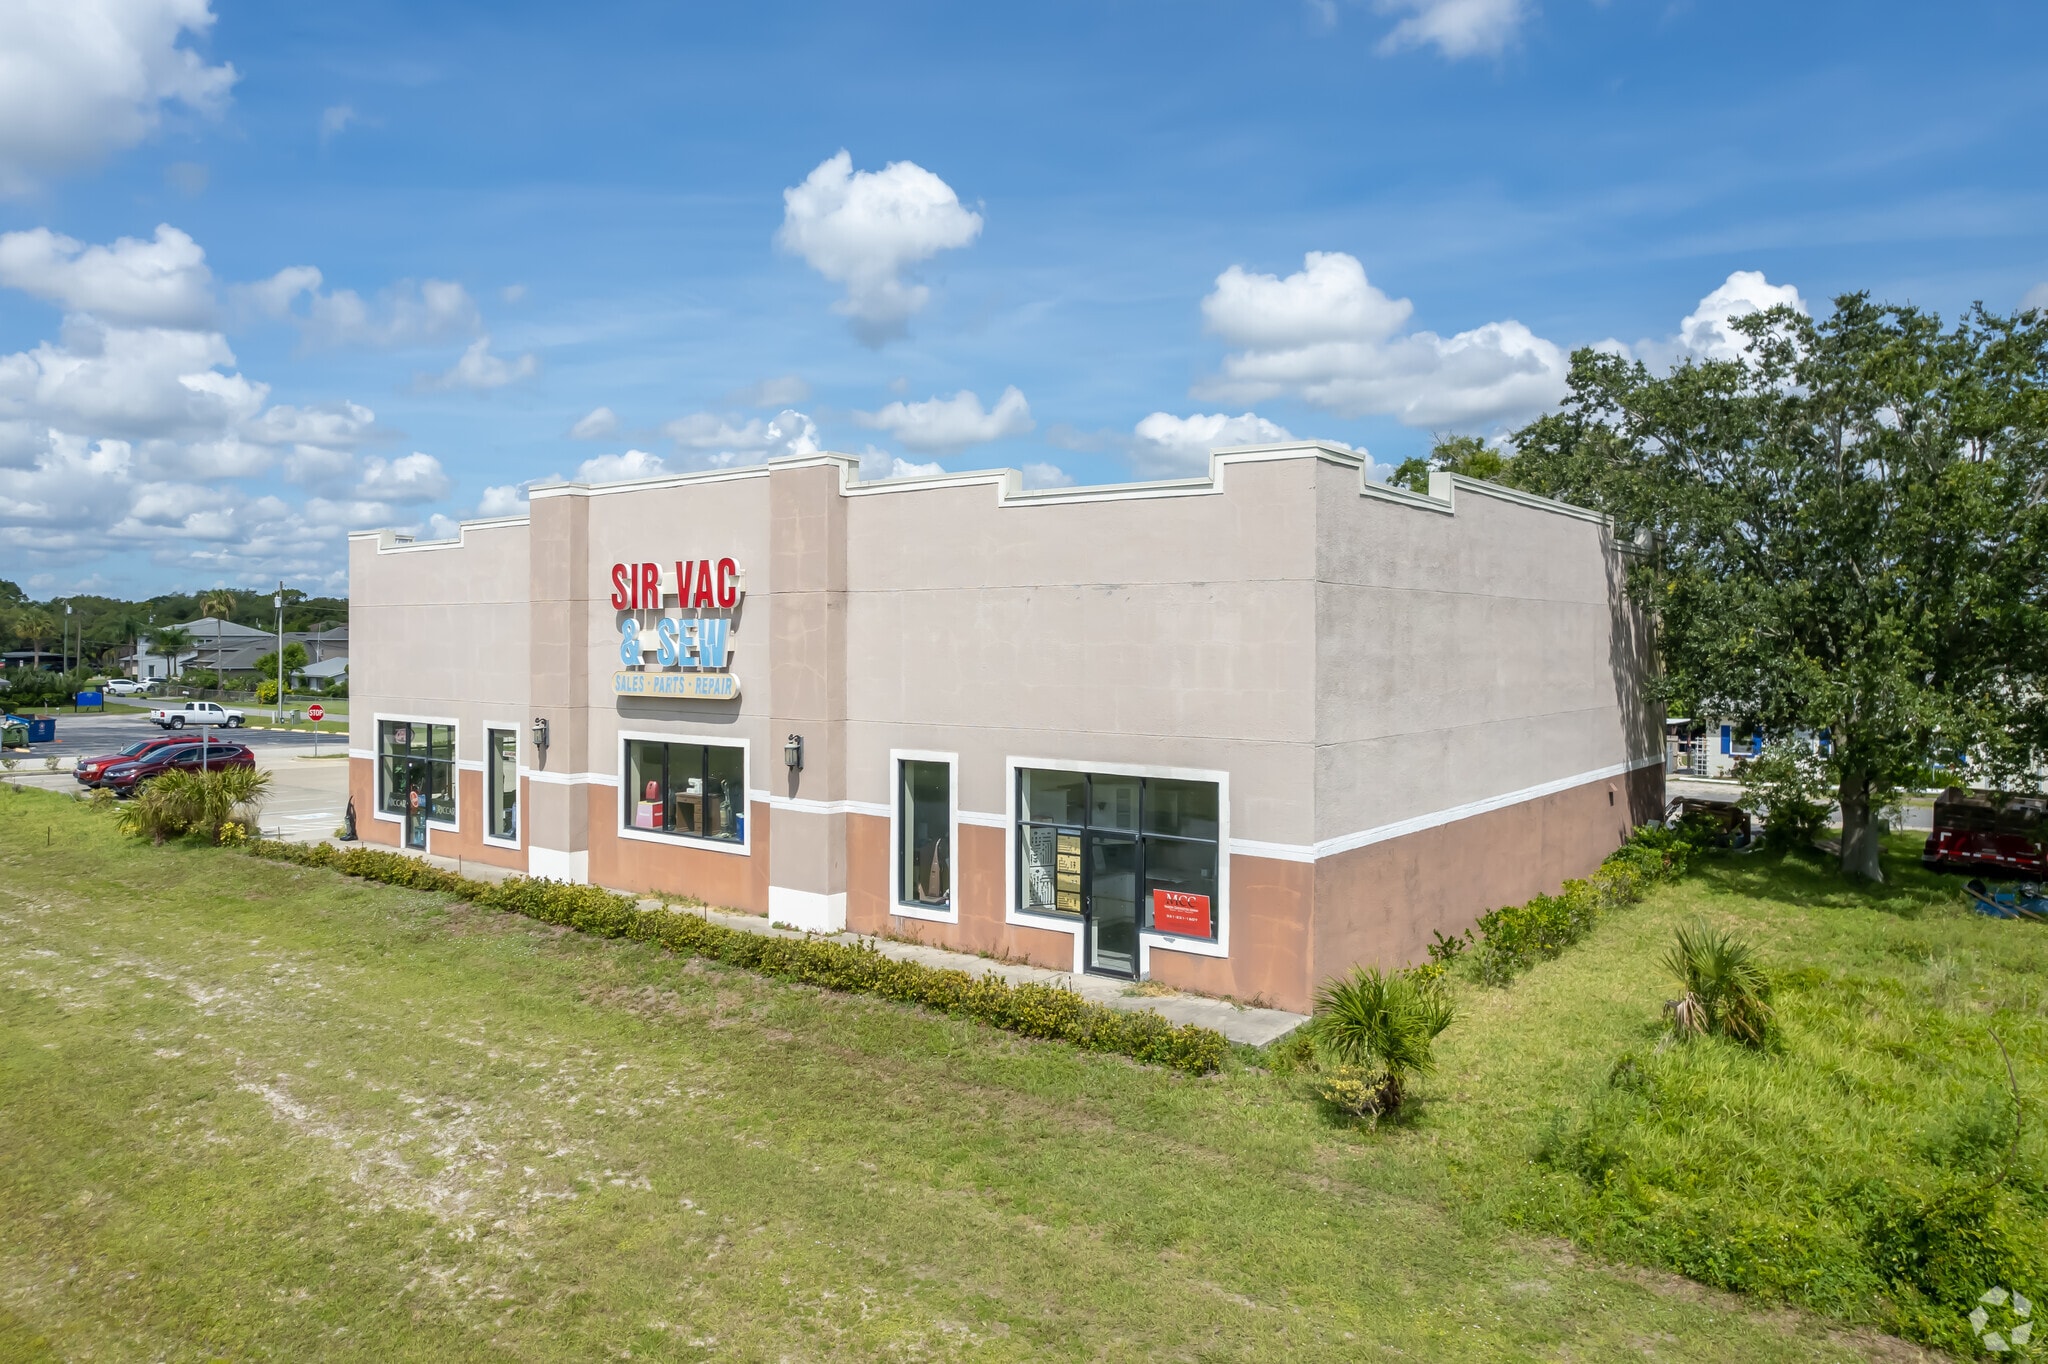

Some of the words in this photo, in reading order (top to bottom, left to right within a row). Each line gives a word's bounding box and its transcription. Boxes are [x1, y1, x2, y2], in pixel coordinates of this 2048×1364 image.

[611, 563, 661, 611] SIR
[675, 557, 738, 609] VAC
[620, 618, 641, 666] &
[657, 617, 729, 668] SEW
[615, 674, 645, 692] SALES
[653, 676, 685, 694] PARTS
[694, 677, 733, 695] REPAIR
[1166, 893, 1197, 908] MCC
